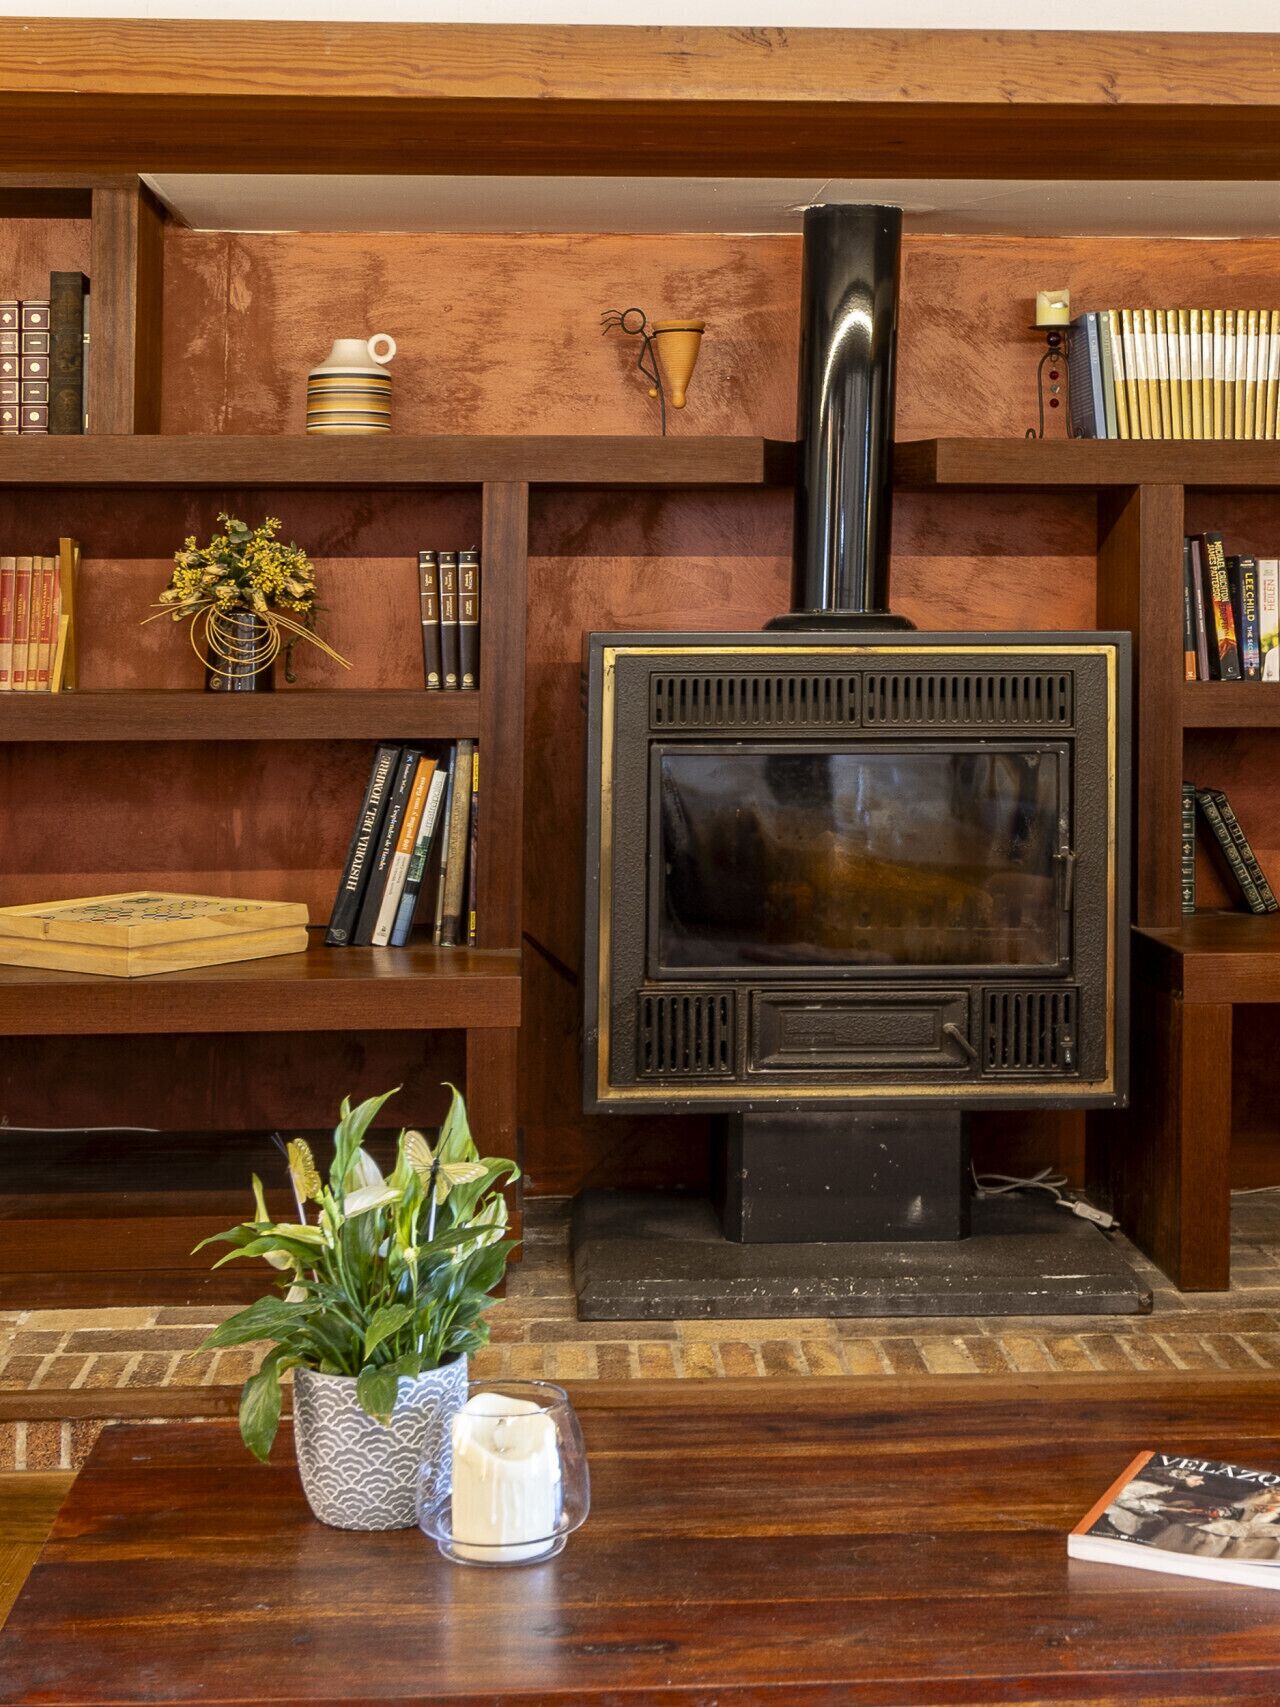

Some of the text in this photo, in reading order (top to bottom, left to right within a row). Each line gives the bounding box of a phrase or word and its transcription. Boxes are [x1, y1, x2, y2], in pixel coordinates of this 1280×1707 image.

[1207, 543, 1220, 601] JAMES PATTERSON
[1214, 541, 1228, 601] MICHAEL CRICHTON
[1245, 572, 1255, 622] LEE CHILD
[345, 755, 390, 891] HISTORIA DEL HOMBRE
[406, 816, 417, 838] paellas
